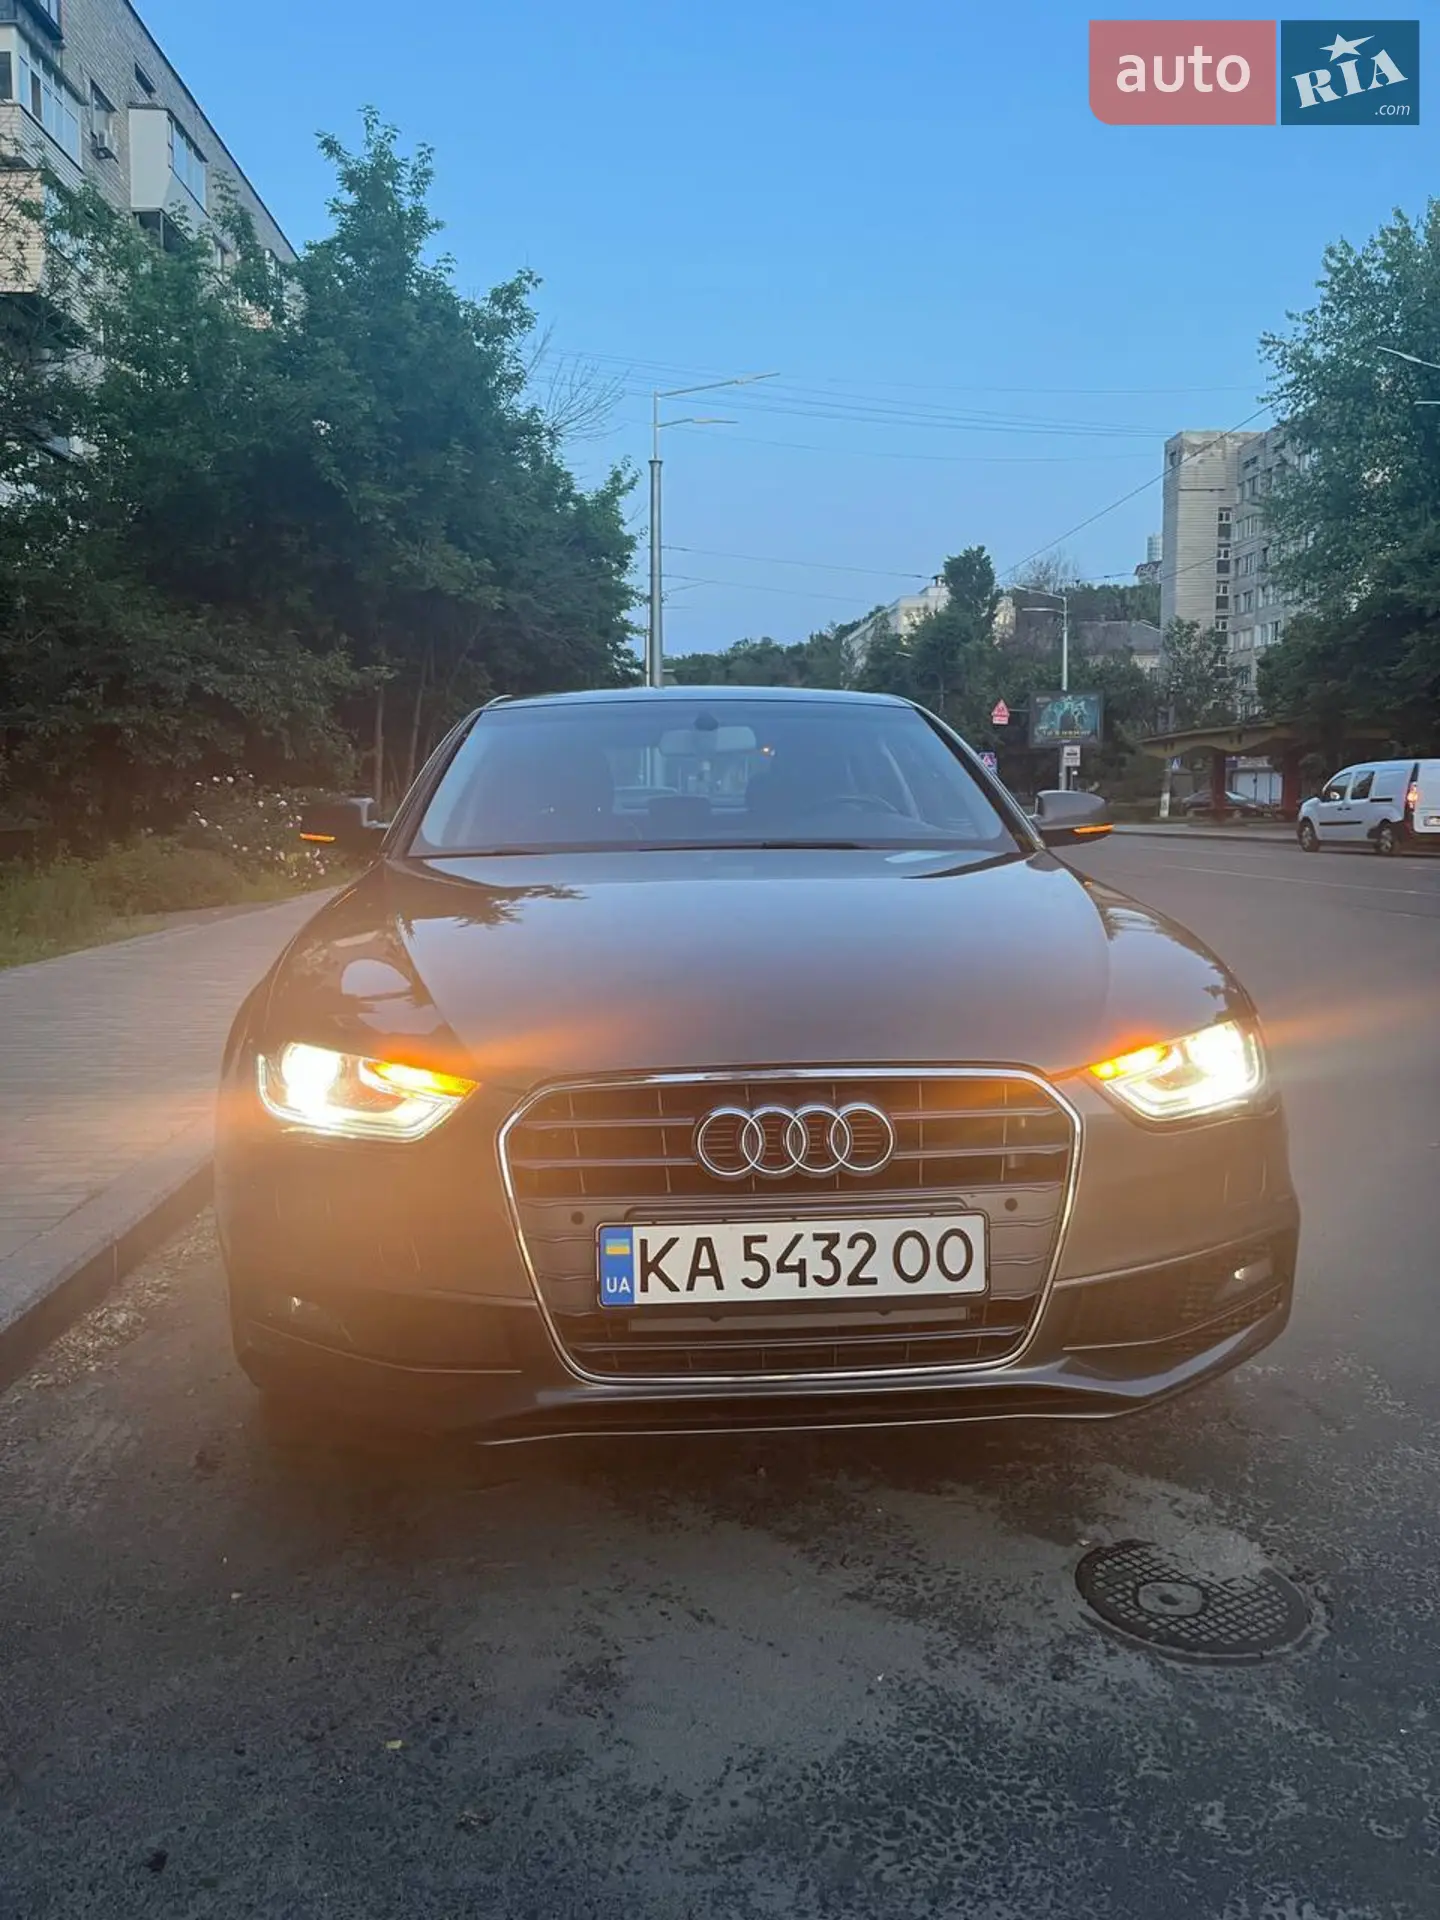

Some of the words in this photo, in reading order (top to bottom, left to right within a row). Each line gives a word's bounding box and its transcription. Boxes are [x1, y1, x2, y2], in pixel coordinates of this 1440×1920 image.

[639, 1236, 725, 1294] KA
[740, 1232, 878, 1290] 5432
[606, 1277, 631, 1294] UA
